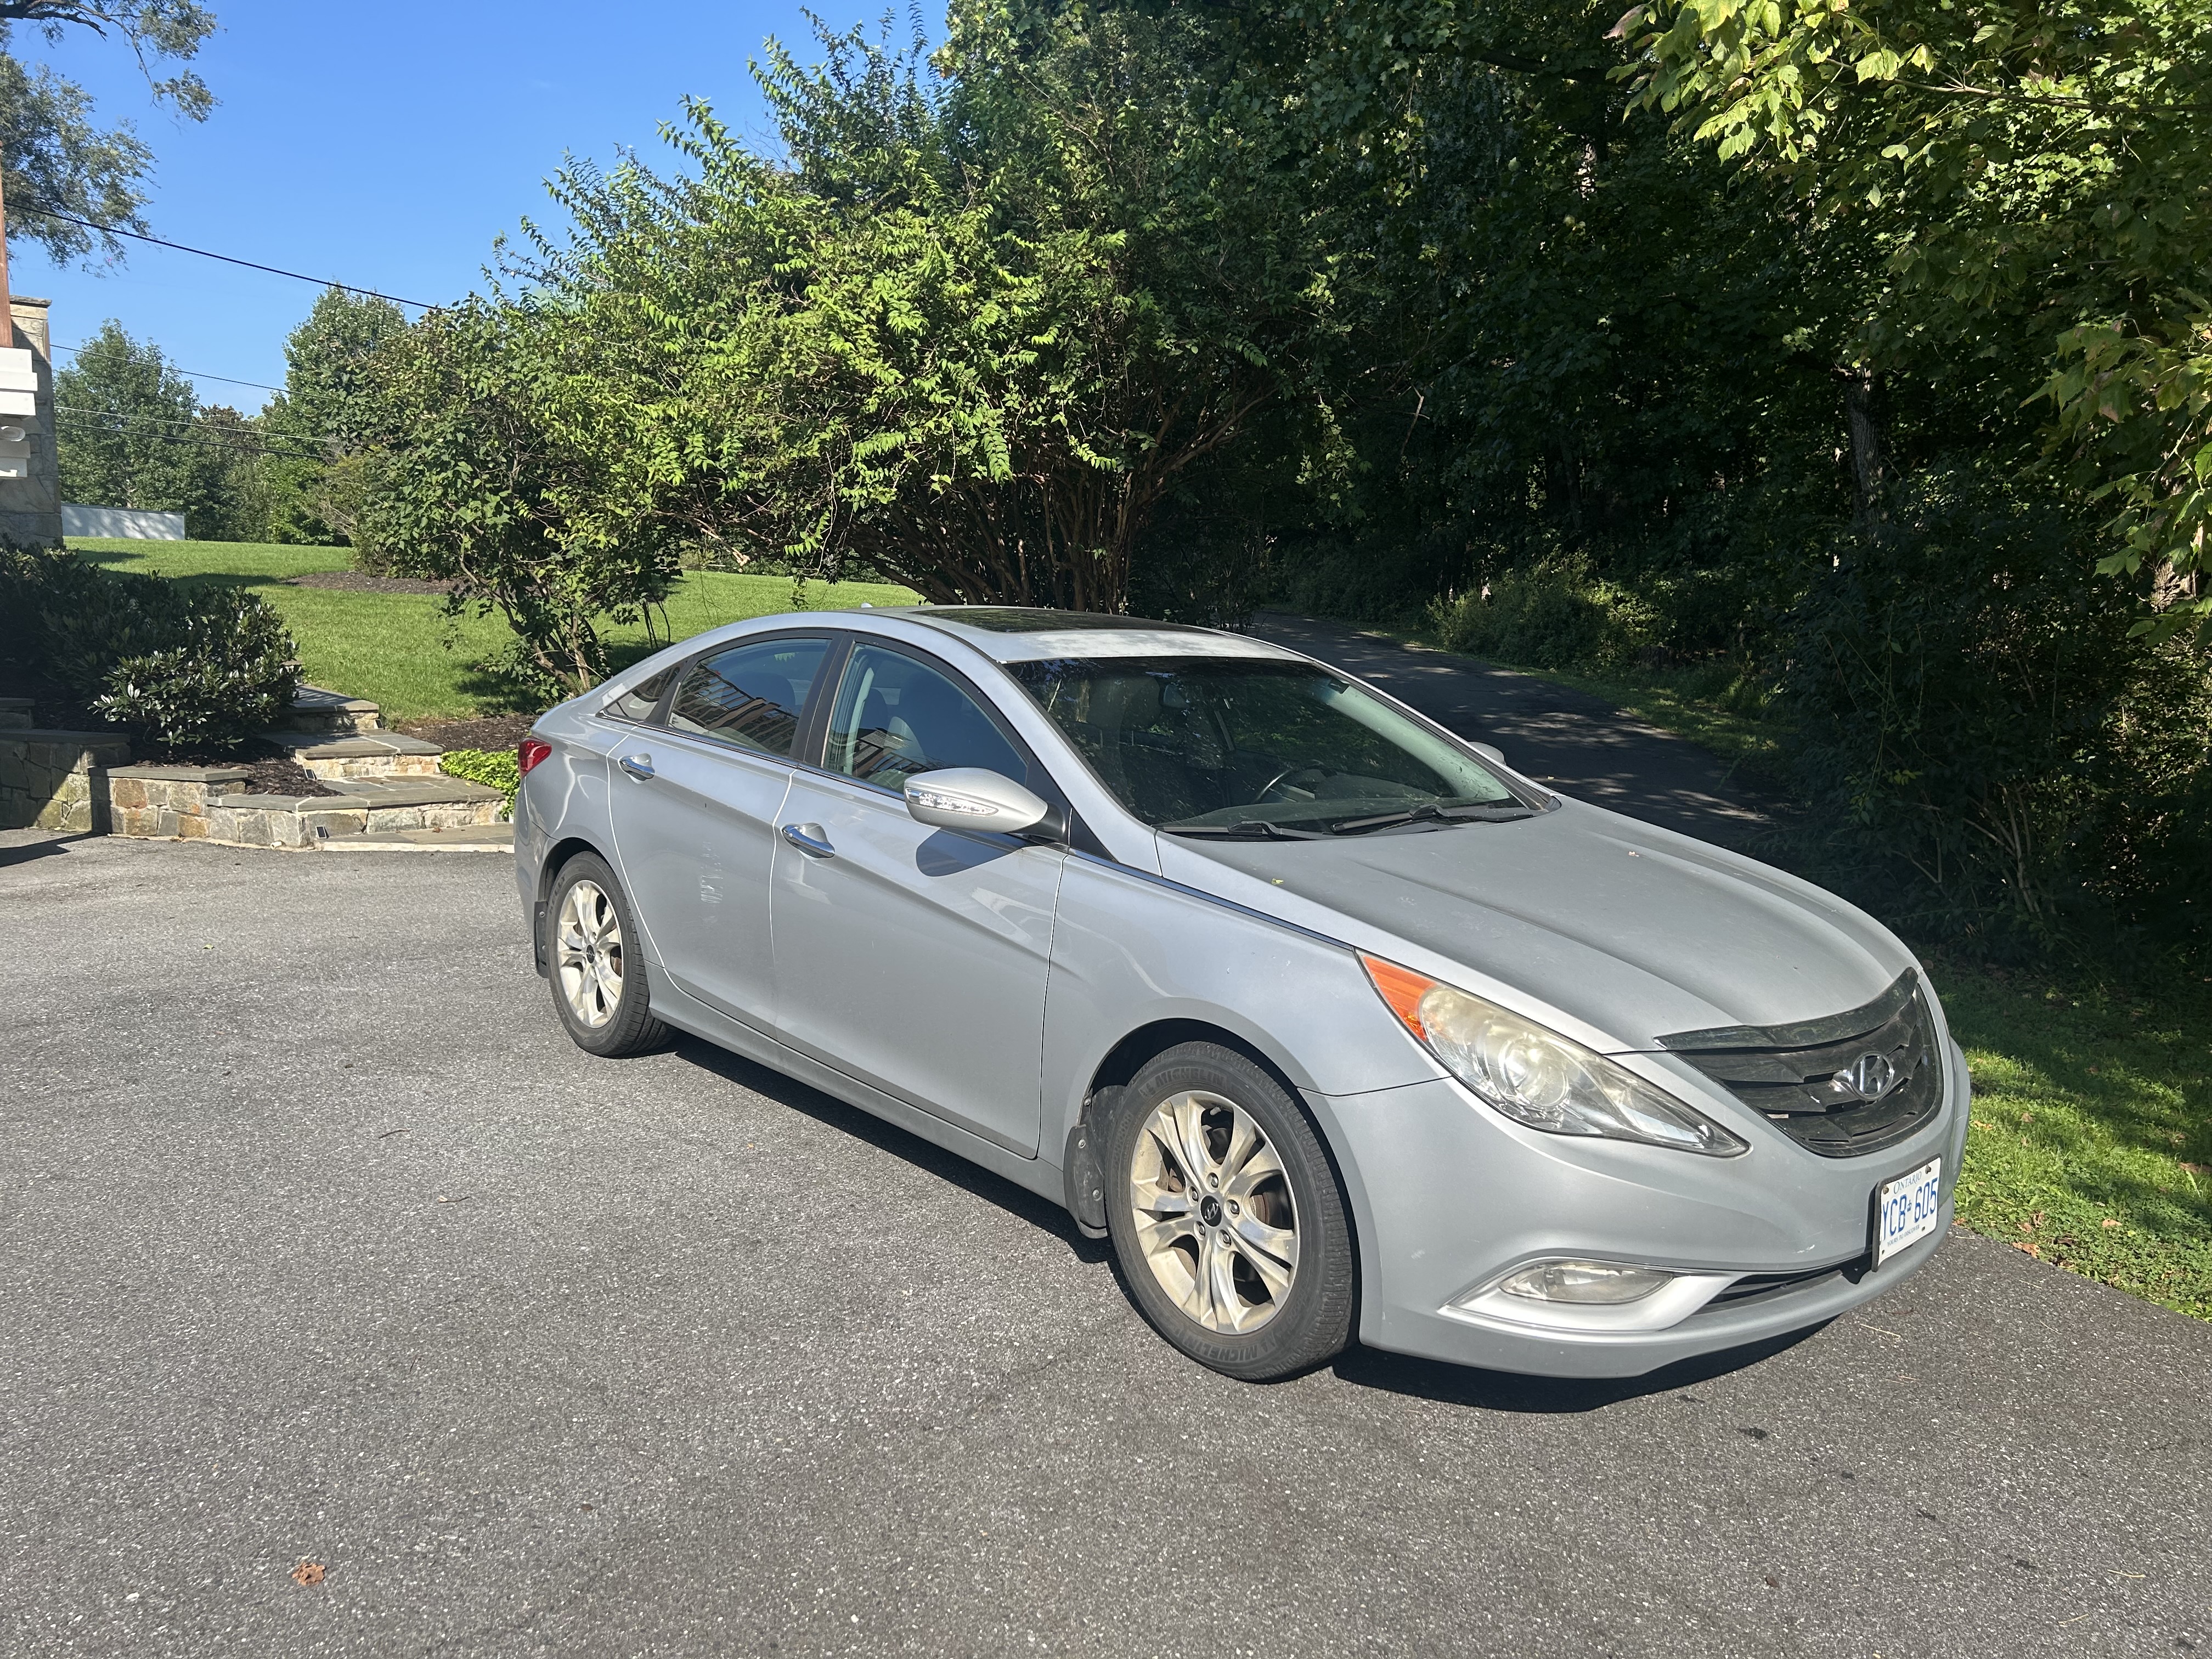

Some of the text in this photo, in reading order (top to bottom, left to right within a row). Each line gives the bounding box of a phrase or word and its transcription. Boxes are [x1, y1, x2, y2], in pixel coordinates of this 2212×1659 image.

[1154, 1067, 1227, 1090] MICHELIN
[1893, 1171, 1922, 1194] ONTARIO
[1882, 1177, 1938, 1241] YCB 605
[1887, 1236, 1898, 1246] YOURS
[1904, 1224, 1920, 1237] DISCOVER
[1182, 1335, 1257, 1361] MICHELIN
